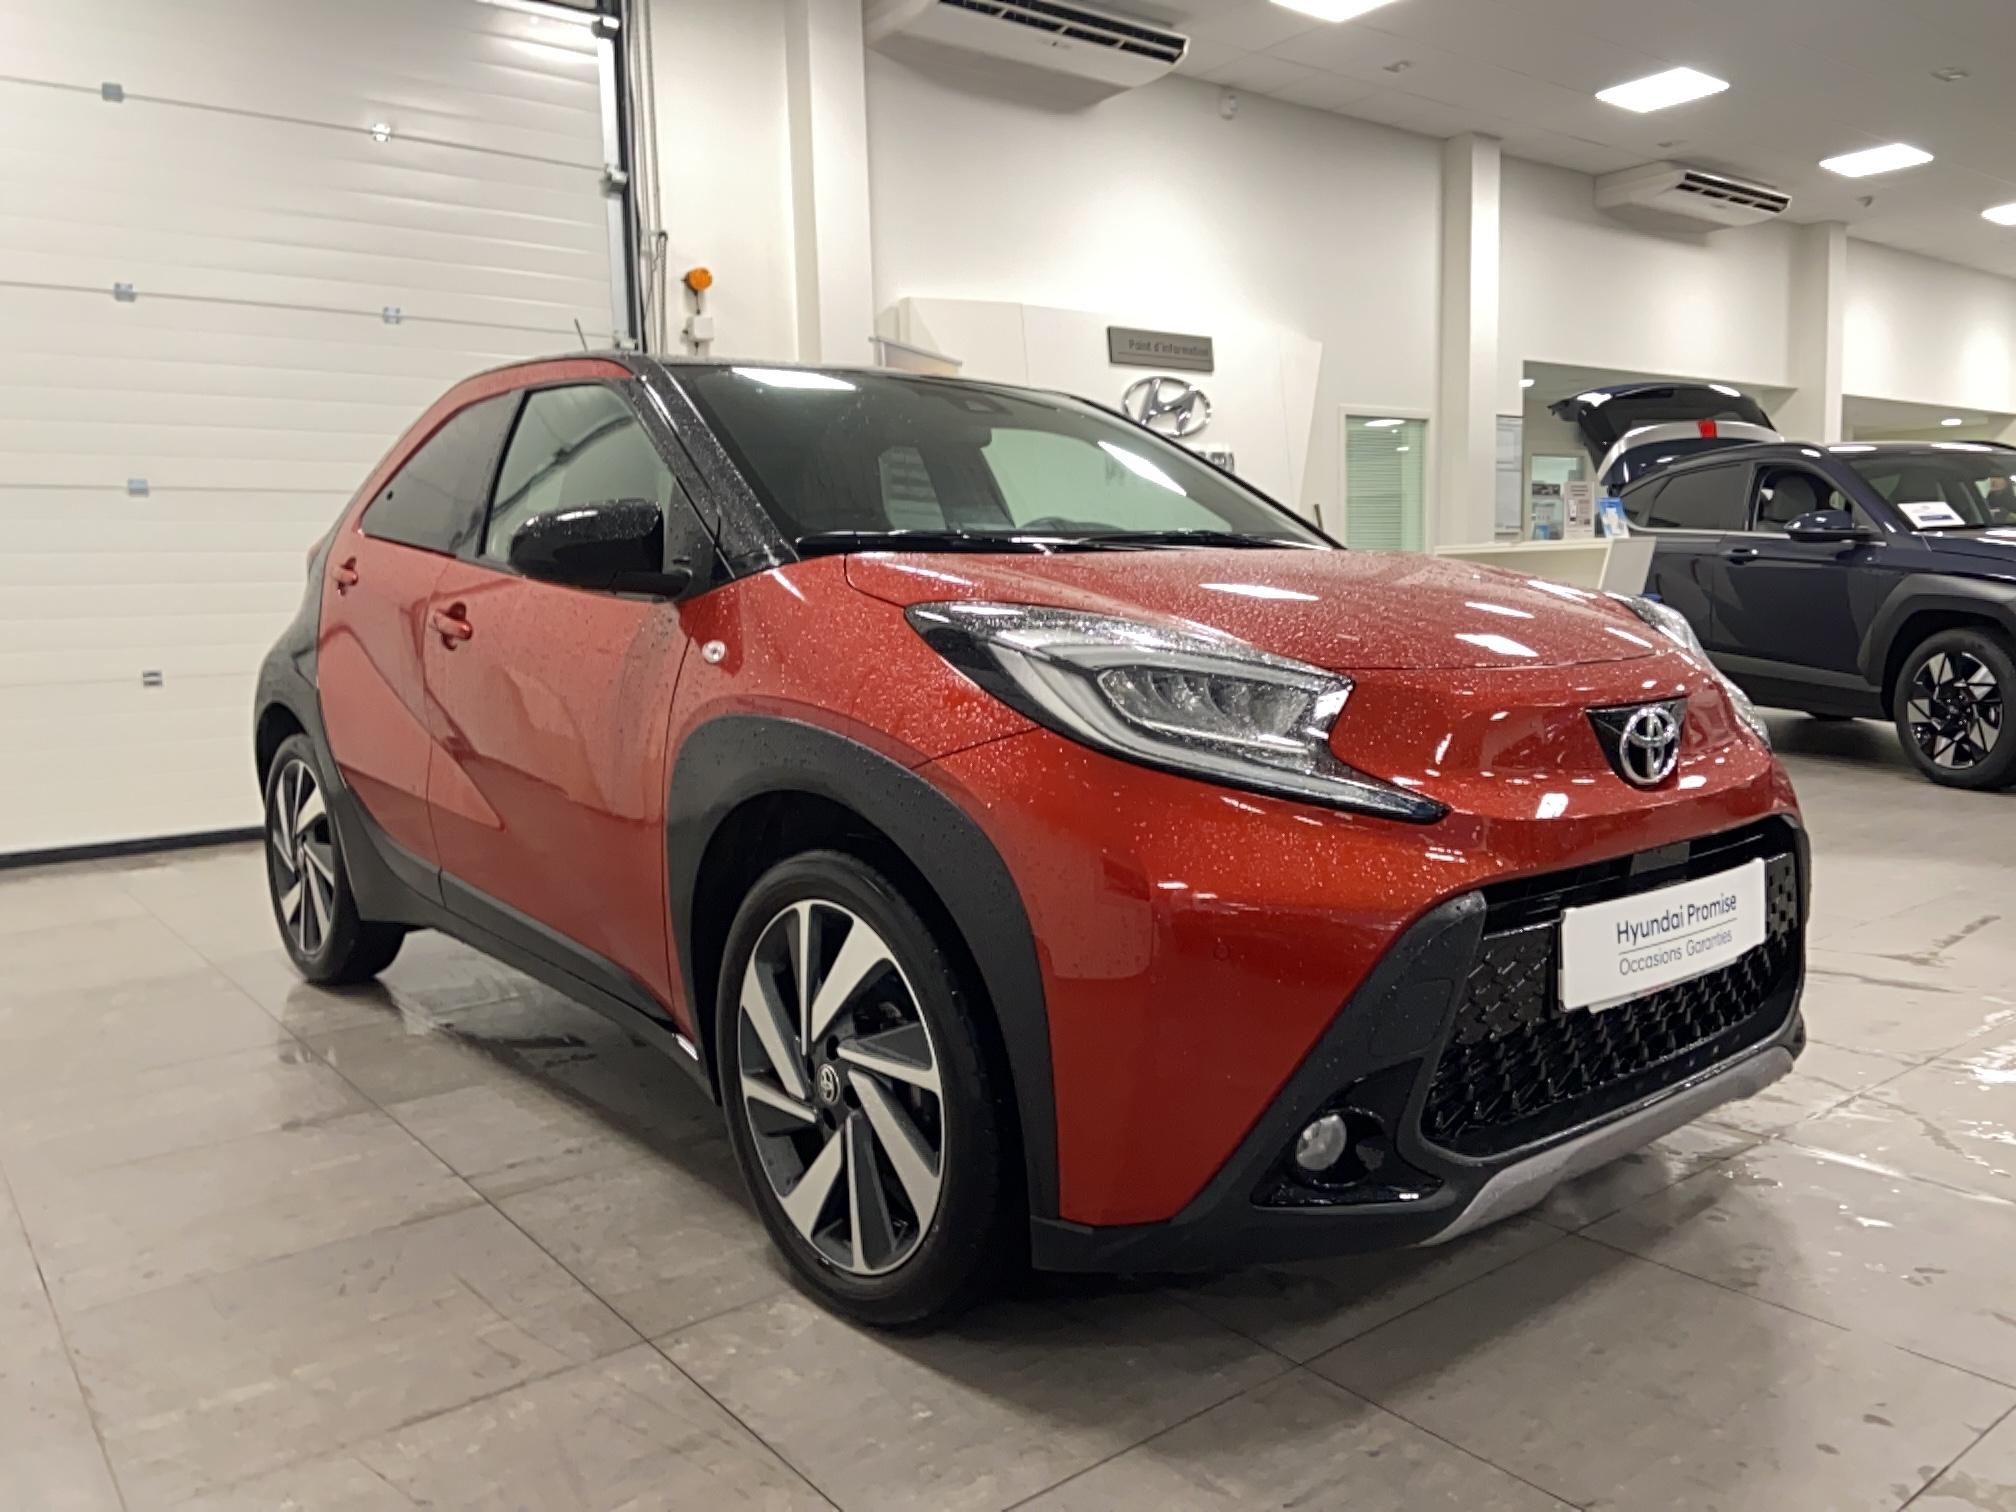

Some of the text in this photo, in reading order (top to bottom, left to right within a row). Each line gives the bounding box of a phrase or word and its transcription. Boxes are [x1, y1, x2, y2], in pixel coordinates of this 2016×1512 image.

[1154, 342, 1209, 355] d'informat
[1616, 893, 1737, 946] Hyundai Promise
[1619, 929, 1733, 976] Occasions Garanties
